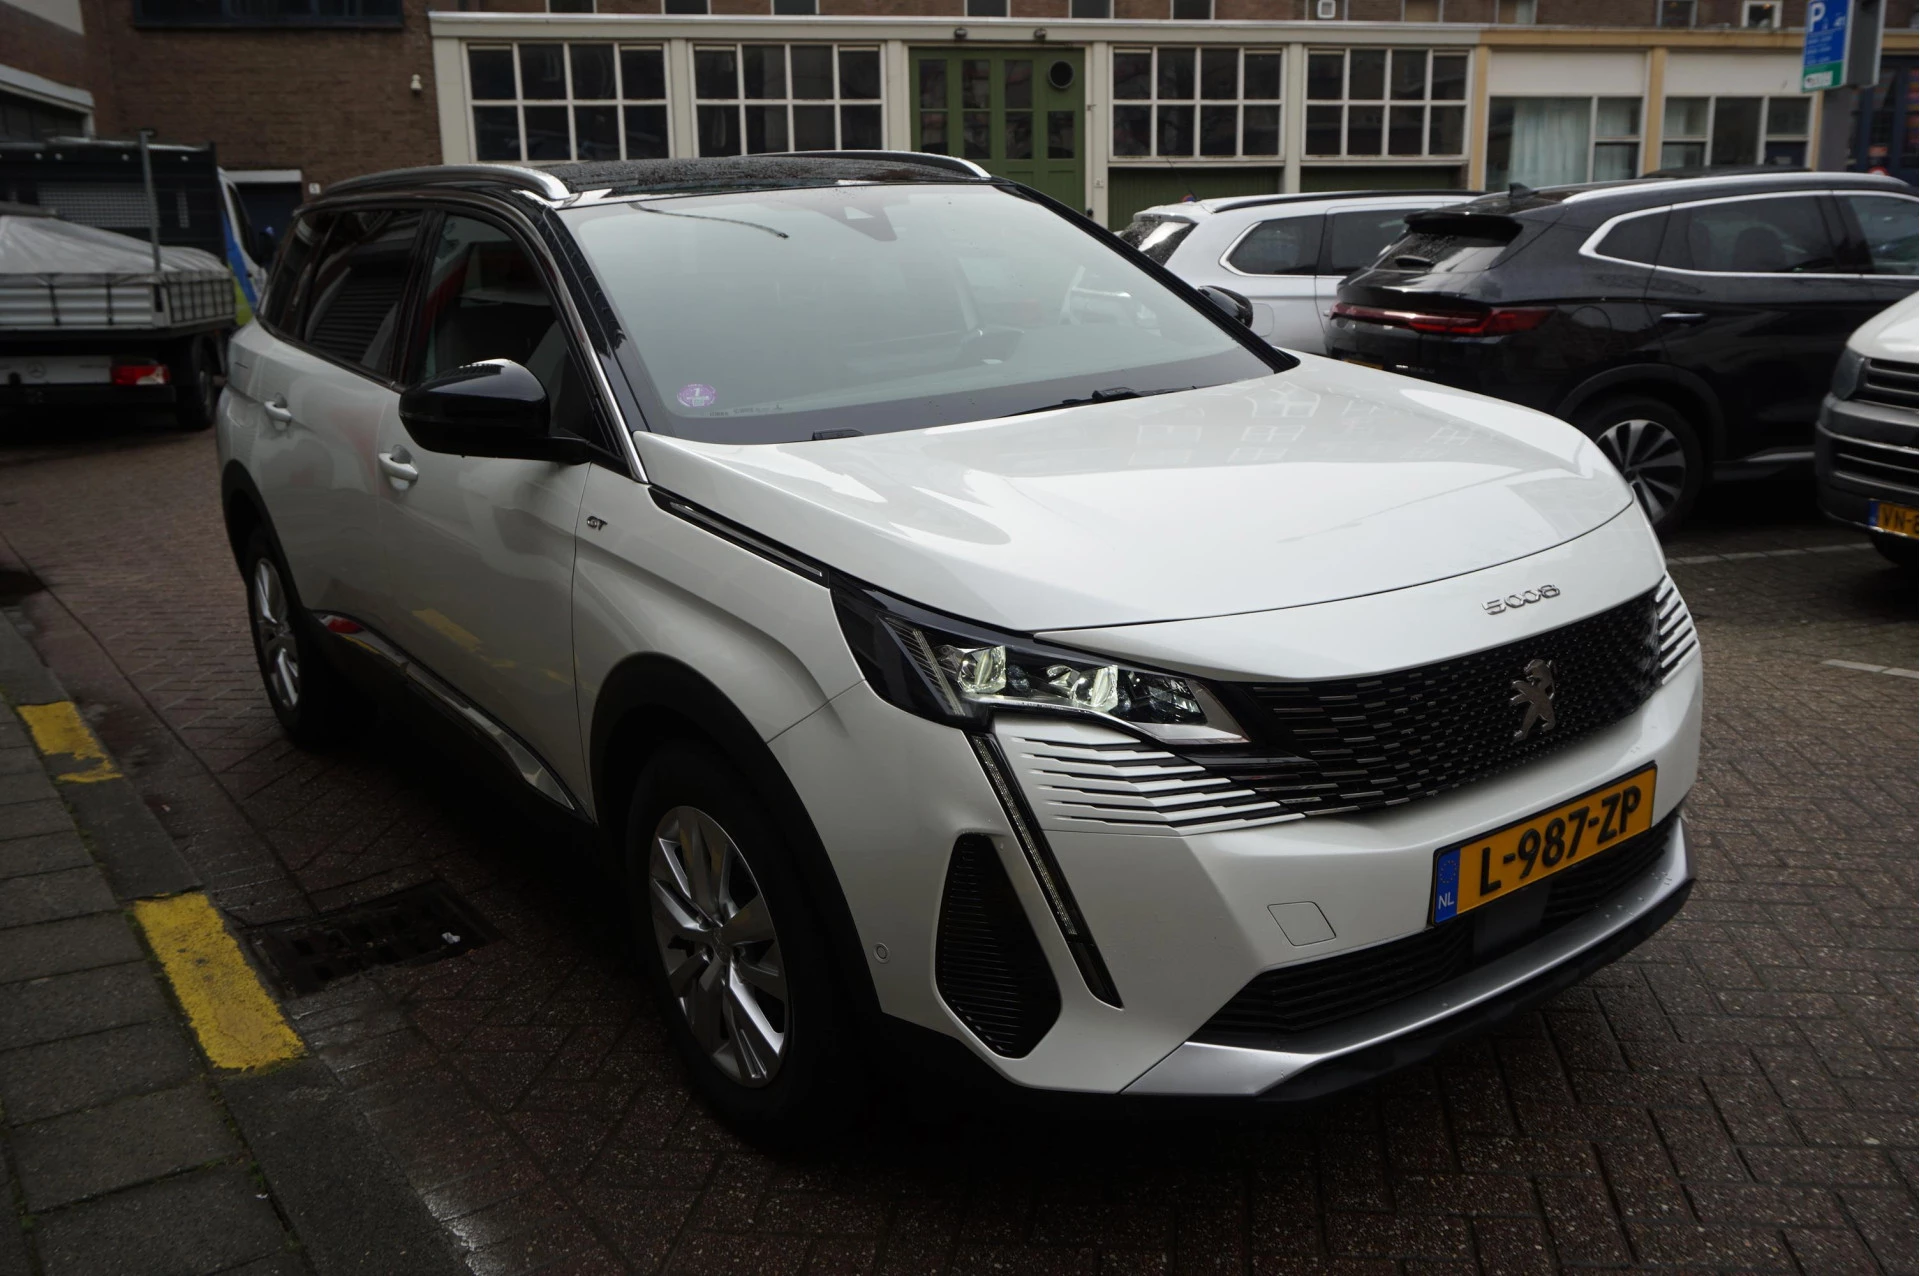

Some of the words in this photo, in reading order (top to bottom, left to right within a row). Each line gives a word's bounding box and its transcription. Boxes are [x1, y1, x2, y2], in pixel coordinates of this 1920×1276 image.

[1808, 1, 1826, 33] P
[586, 515, 608, 531] GT
[1481, 584, 1561, 615] 5008
[1479, 785, 1642, 897] L-987-ZP
[1438, 891, 1455, 910] NL
